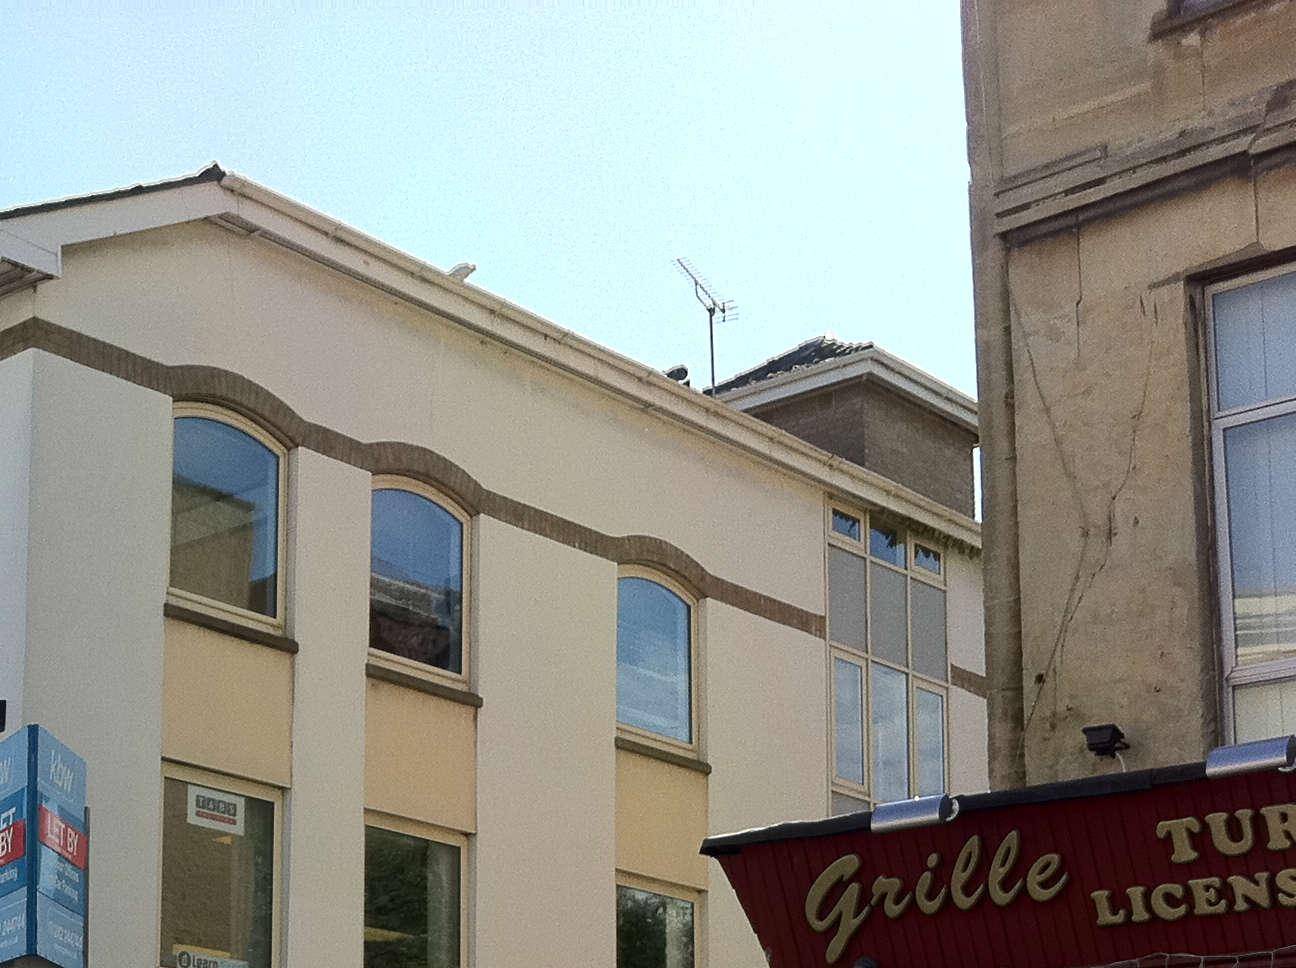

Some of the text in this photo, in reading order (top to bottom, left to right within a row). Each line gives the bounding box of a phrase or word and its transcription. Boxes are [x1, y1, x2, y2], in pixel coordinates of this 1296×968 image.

[0, 827, 14, 857] BY
[47, 812, 79, 856] LET BY
[804, 828, 1070, 966] Grille
[1090, 868, 1296, 926] LICENS
